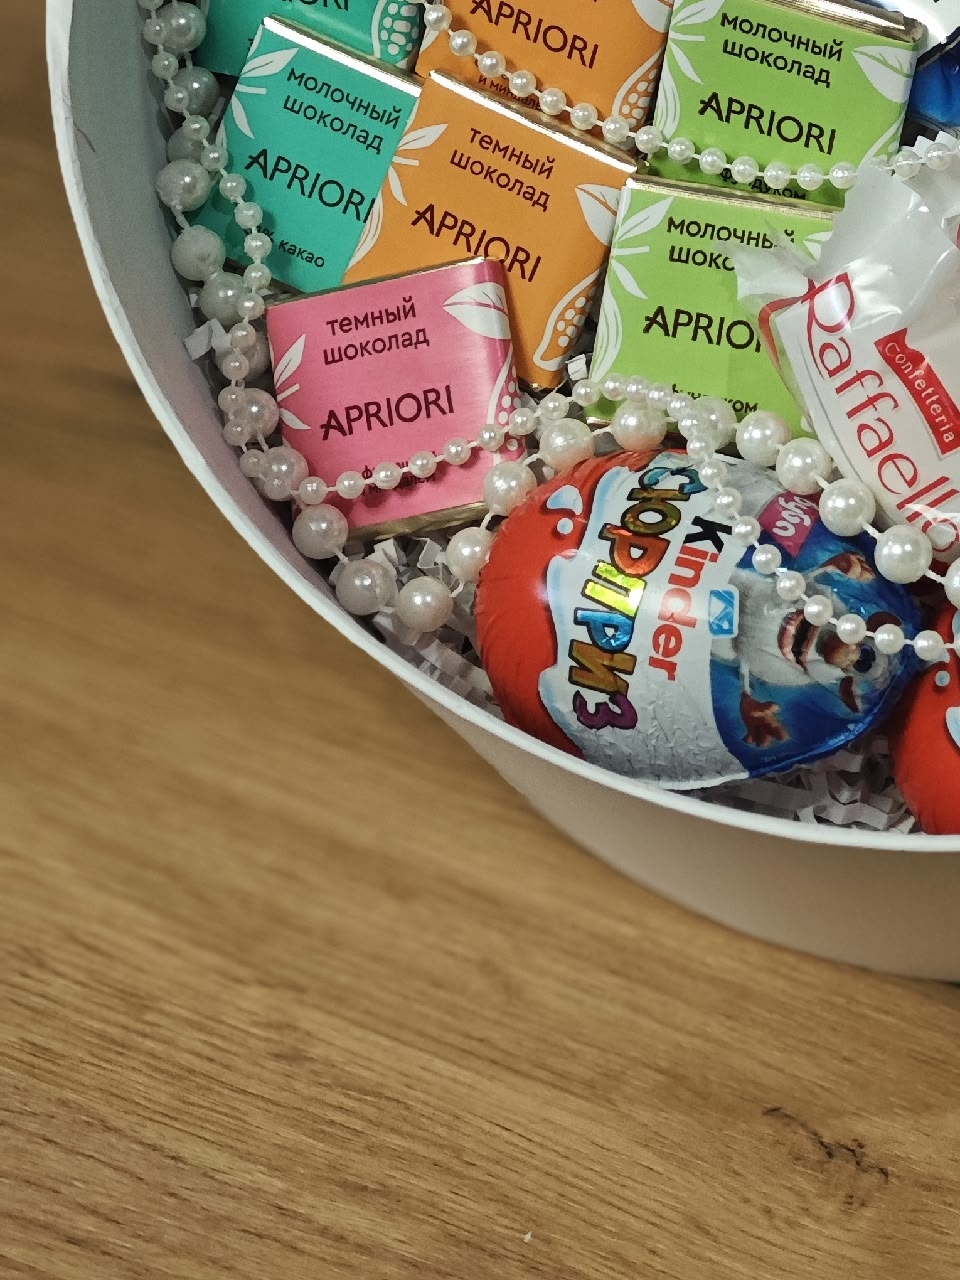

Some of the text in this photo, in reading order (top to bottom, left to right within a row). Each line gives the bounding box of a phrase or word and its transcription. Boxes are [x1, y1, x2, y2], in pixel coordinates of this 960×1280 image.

[719, 10, 845, 64] молочный
[721, 38, 833, 89] шоколад
[283, 94, 384, 155] шоколад
[286, 67, 403, 130] молочный
[698, 90, 838, 156] APRIORI
[449, 149, 551, 211] шоколад
[468, 126, 555, 181] темный
[244, 148, 377, 224] APRIORI
[279, 239, 325, 268] какао
[411, 203, 542, 284] APRIORI
[322, 327, 430, 367] шоколад
[326, 295, 418, 337] темный
[319, 384, 455, 442] APRIORI
[801, 272, 960, 552] Raffaello
[885, 341, 956, 444] Confetteria
[567, 466, 707, 731] СЮРПРИЗ
[648, 515, 732, 681] Kinder
